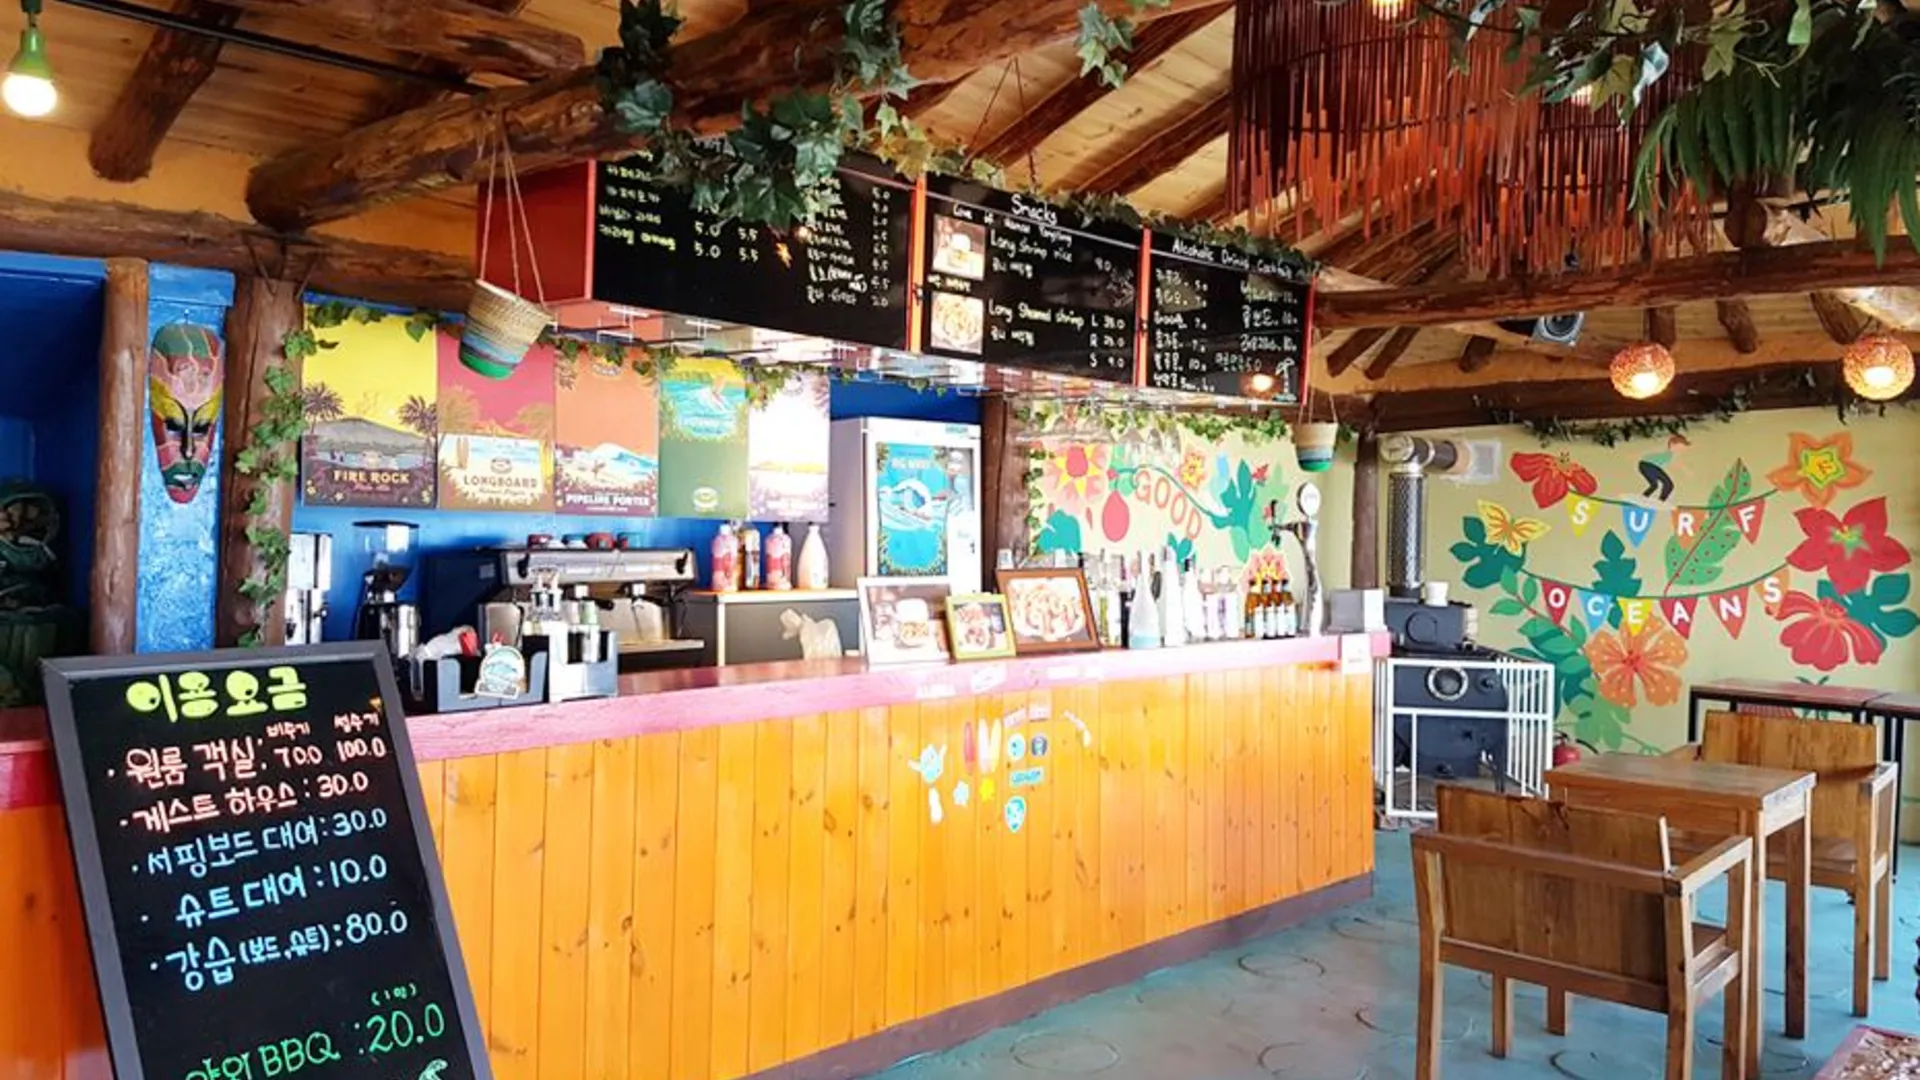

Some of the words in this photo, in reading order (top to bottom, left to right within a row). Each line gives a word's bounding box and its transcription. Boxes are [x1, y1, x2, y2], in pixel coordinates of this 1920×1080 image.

[988, 298, 1013, 323] Long
[333, 469, 367, 483] FIRE
[370, 471, 411, 485] ROCK
[463, 475, 538, 489] LONGBOARD
[1135, 470, 1202, 540] GOOD
[126, 746, 188, 790] 원룸
[336, 736, 387, 763] 100.0
[131, 793, 221, 834] 게스트
[316, 770, 369, 799] 30.0
[147, 831, 259, 878] 서핑보드
[175, 886, 241, 929] 슈트
[258, 1031, 341, 1078] BBQ
